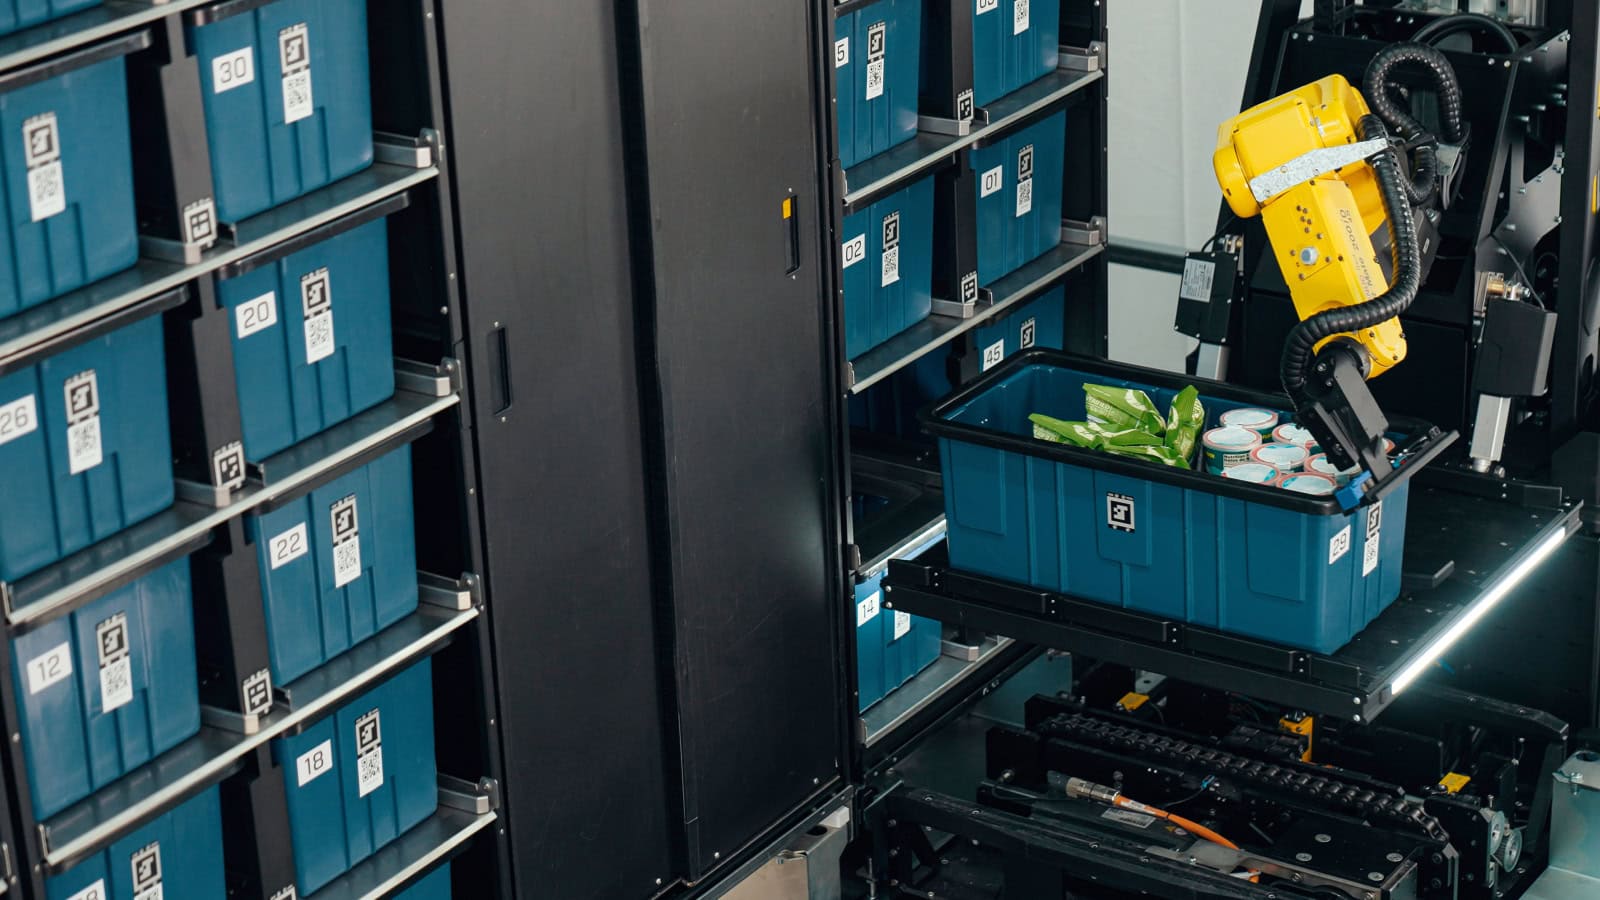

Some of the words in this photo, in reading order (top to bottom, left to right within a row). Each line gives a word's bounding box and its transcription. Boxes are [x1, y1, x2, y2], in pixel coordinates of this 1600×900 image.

[220, 56, 246, 84] 30
[985, 172, 998, 191] 01
[845, 240, 862, 262] 02
[243, 300, 270, 329] 20
[986, 344, 1001, 364] 45
[0, 405, 28, 435] 26
[277, 532, 301, 560] 22
[1333, 533, 1346, 556] 29
[862, 599, 875, 618] 14
[38, 655, 61, 681] 12
[304, 750, 324, 776] 18
